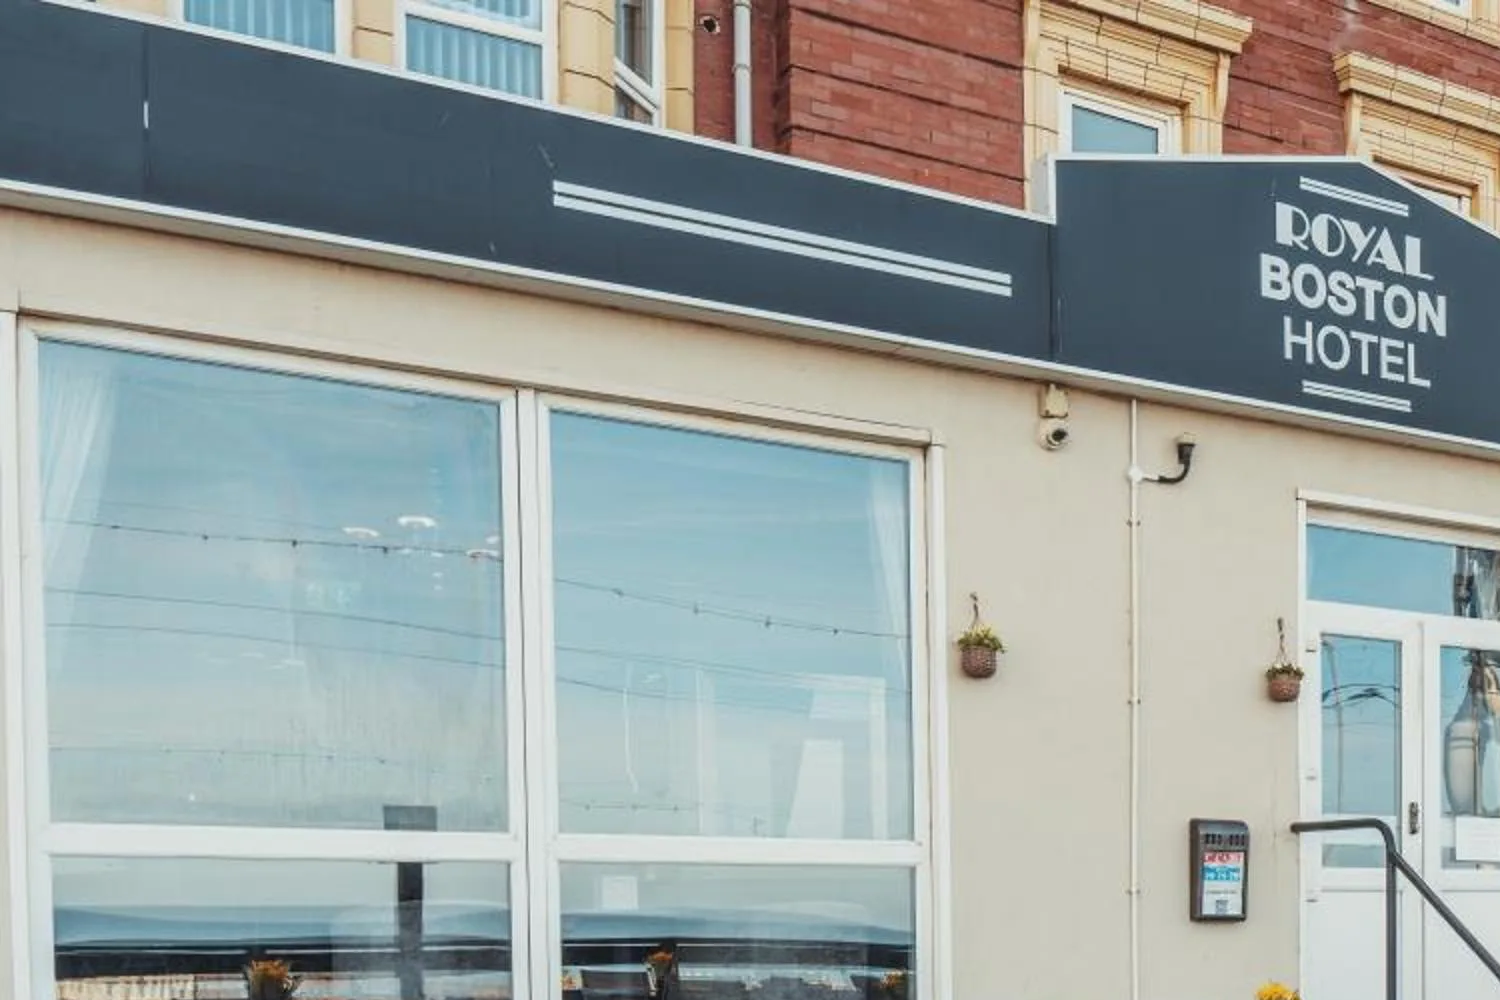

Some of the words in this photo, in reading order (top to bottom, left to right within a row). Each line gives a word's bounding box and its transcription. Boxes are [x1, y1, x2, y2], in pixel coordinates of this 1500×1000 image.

[1275, 201, 1435, 281] ROYAL
[1260, 252, 1447, 337] BOSTON
[1283, 315, 1431, 388] HOTEL
